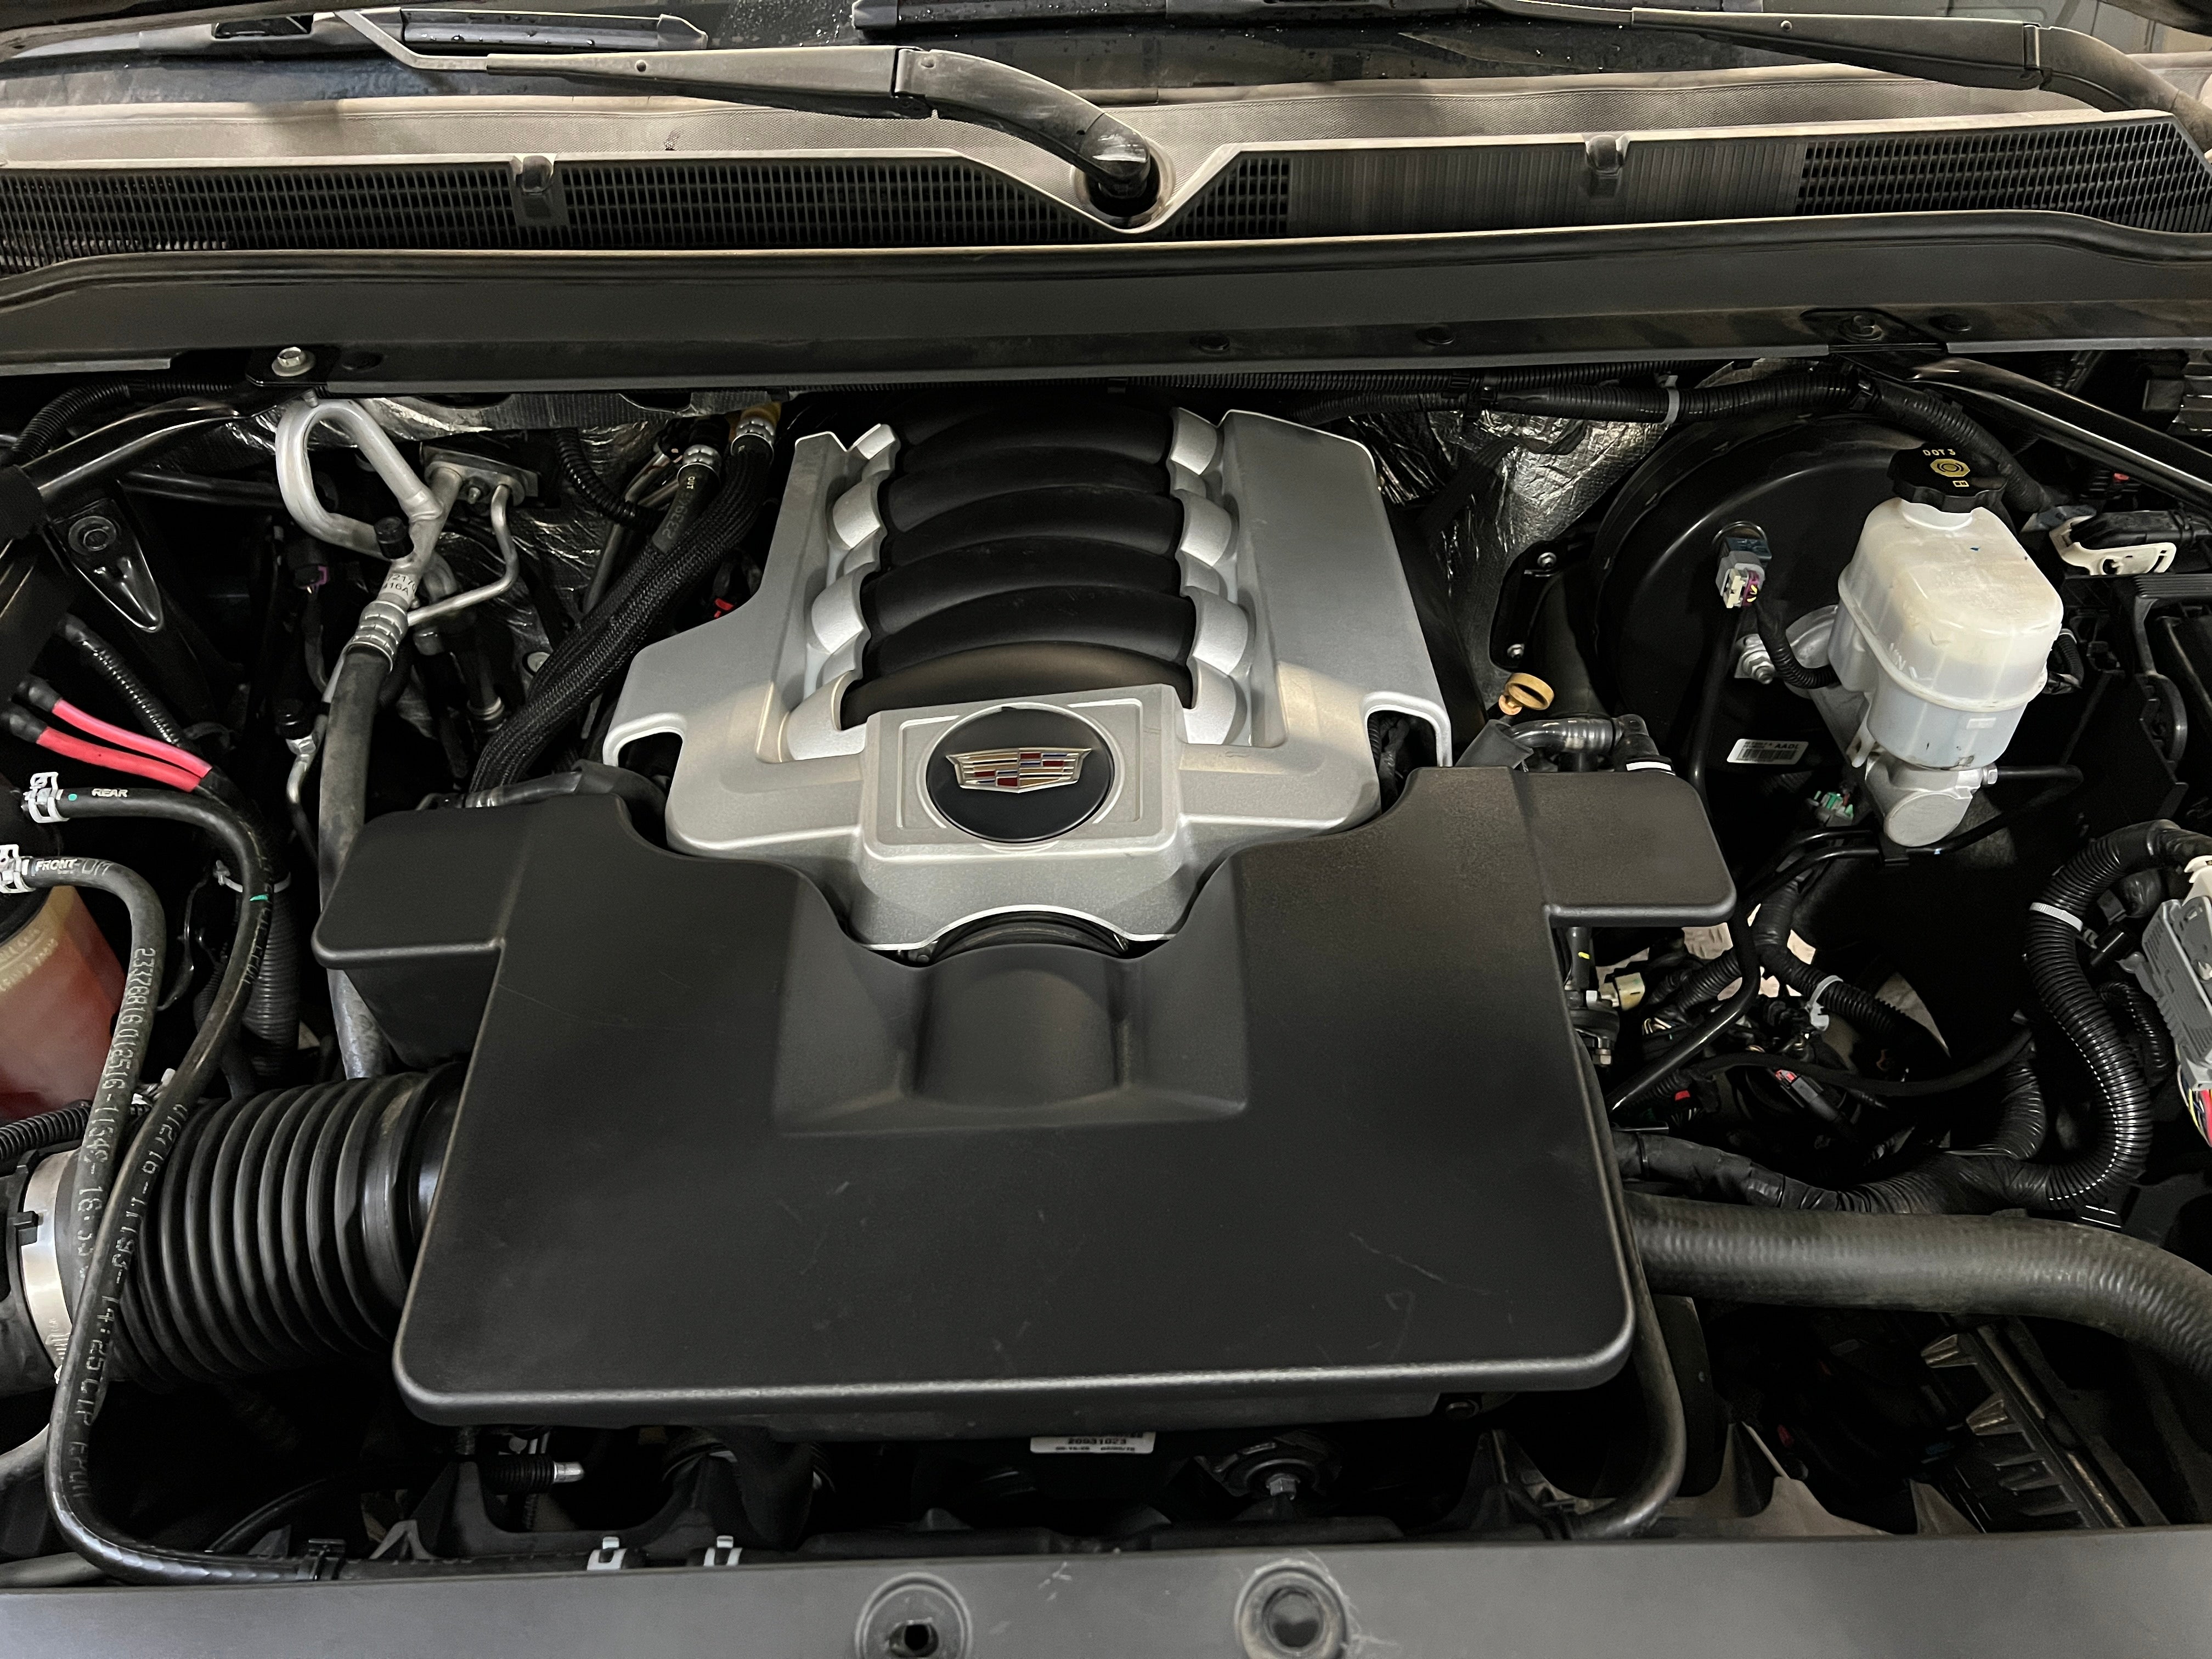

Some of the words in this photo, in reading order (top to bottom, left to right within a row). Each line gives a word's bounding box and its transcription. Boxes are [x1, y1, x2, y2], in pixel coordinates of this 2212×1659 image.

[686, 476, 696, 490] OUT
[91, 788, 128, 798] REAR
[35, 858, 78, 872] FRONT
